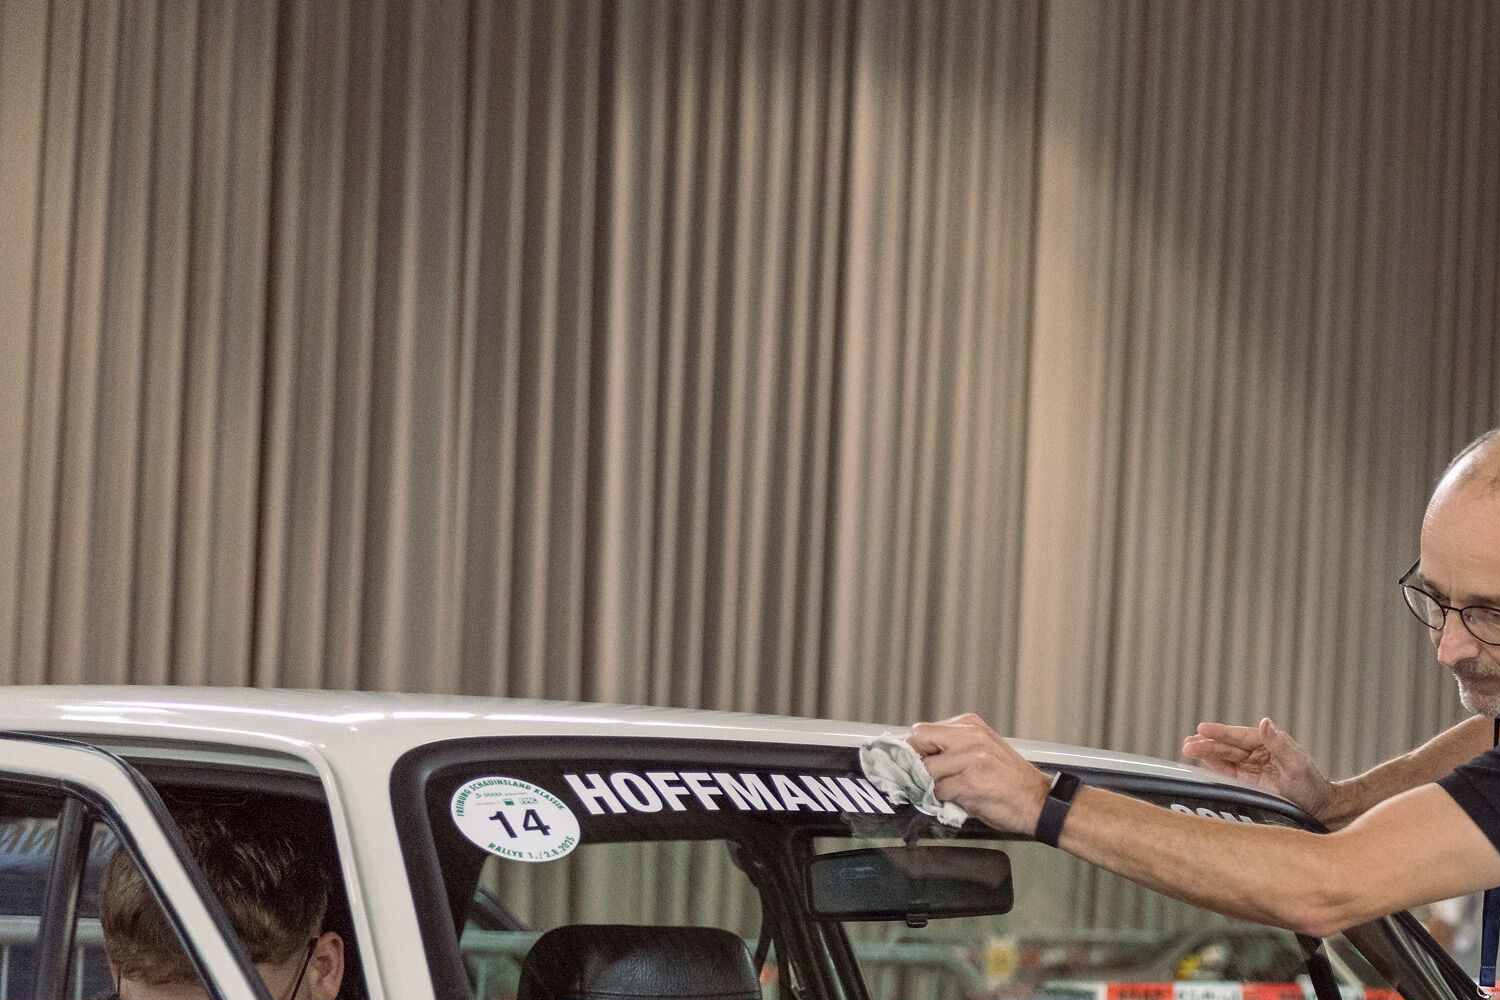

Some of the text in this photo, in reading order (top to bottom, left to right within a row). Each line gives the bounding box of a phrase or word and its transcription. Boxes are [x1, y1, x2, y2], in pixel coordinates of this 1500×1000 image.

[456, 778, 565, 817] FREIBURG SCHAUINSLAND KLASSIK
[563, 771, 896, 815] HOFFMANN
[488, 808, 552, 839] 14
[488, 842, 524, 858] RALLYE
